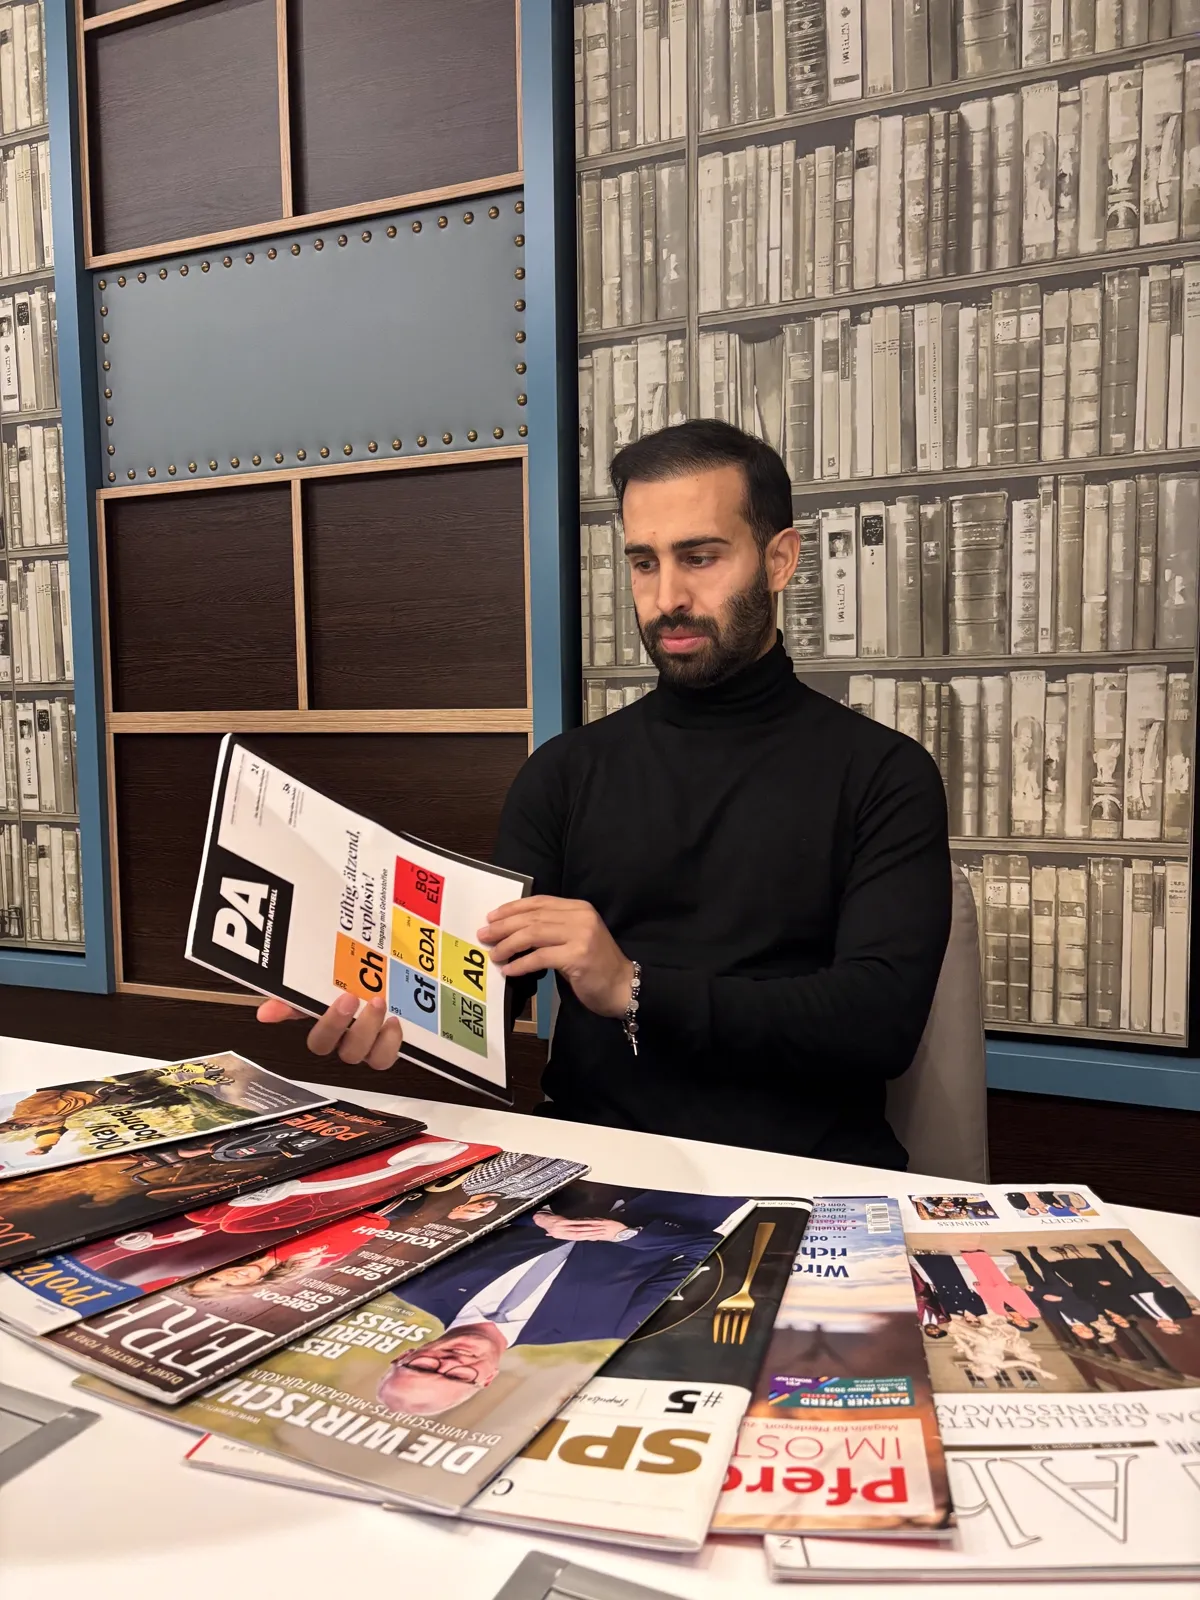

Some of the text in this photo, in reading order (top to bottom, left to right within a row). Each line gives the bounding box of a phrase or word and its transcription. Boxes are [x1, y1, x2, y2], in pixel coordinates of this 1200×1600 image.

[339, 829, 361, 933] Giftig, ätzend,
[380, 868, 389, 908] Gefahrstoffen
[415, 869, 430, 893] BO
[427, 874, 440, 905] ELV
[211, 876, 270, 965] PA
[360, 872, 377, 943] explosiv!
[261, 888, 278, 969] PRÄVENTION AKTUELL
[377, 922, 387, 950] Umgang
[418, 927, 437, 973] GDA
[360, 950, 384, 993] Ch
[462, 948, 485, 991] Ab
[413, 975, 437, 1014] Gf
[458, 996, 473, 1030] ÄTZ
[472, 1003, 484, 1039] END
[352, 1226, 443, 1249] KOLLEGAH
[936, 1220, 990, 1228] BUSINESS
[1039, 1217, 1090, 1225] SOCIETY
[13, 1262, 113, 1307] ProVi
[333, 1265, 382, 1282] GARY
[363, 1262, 394, 1275] VEE
[253, 1288, 320, 1311] GREGOR
[299, 1289, 334, 1305] GYSI
[349, 1311, 432, 1342] SPASS
[248, 1369, 502, 1446] DAS WIRTSCHAFTS-MAGAZIN FÜR KÖLN
[800, 1396, 910, 1408] PARTNER PFERD
[398, 1434, 490, 1474] DIE
[847, 1436, 901, 1459] IM
